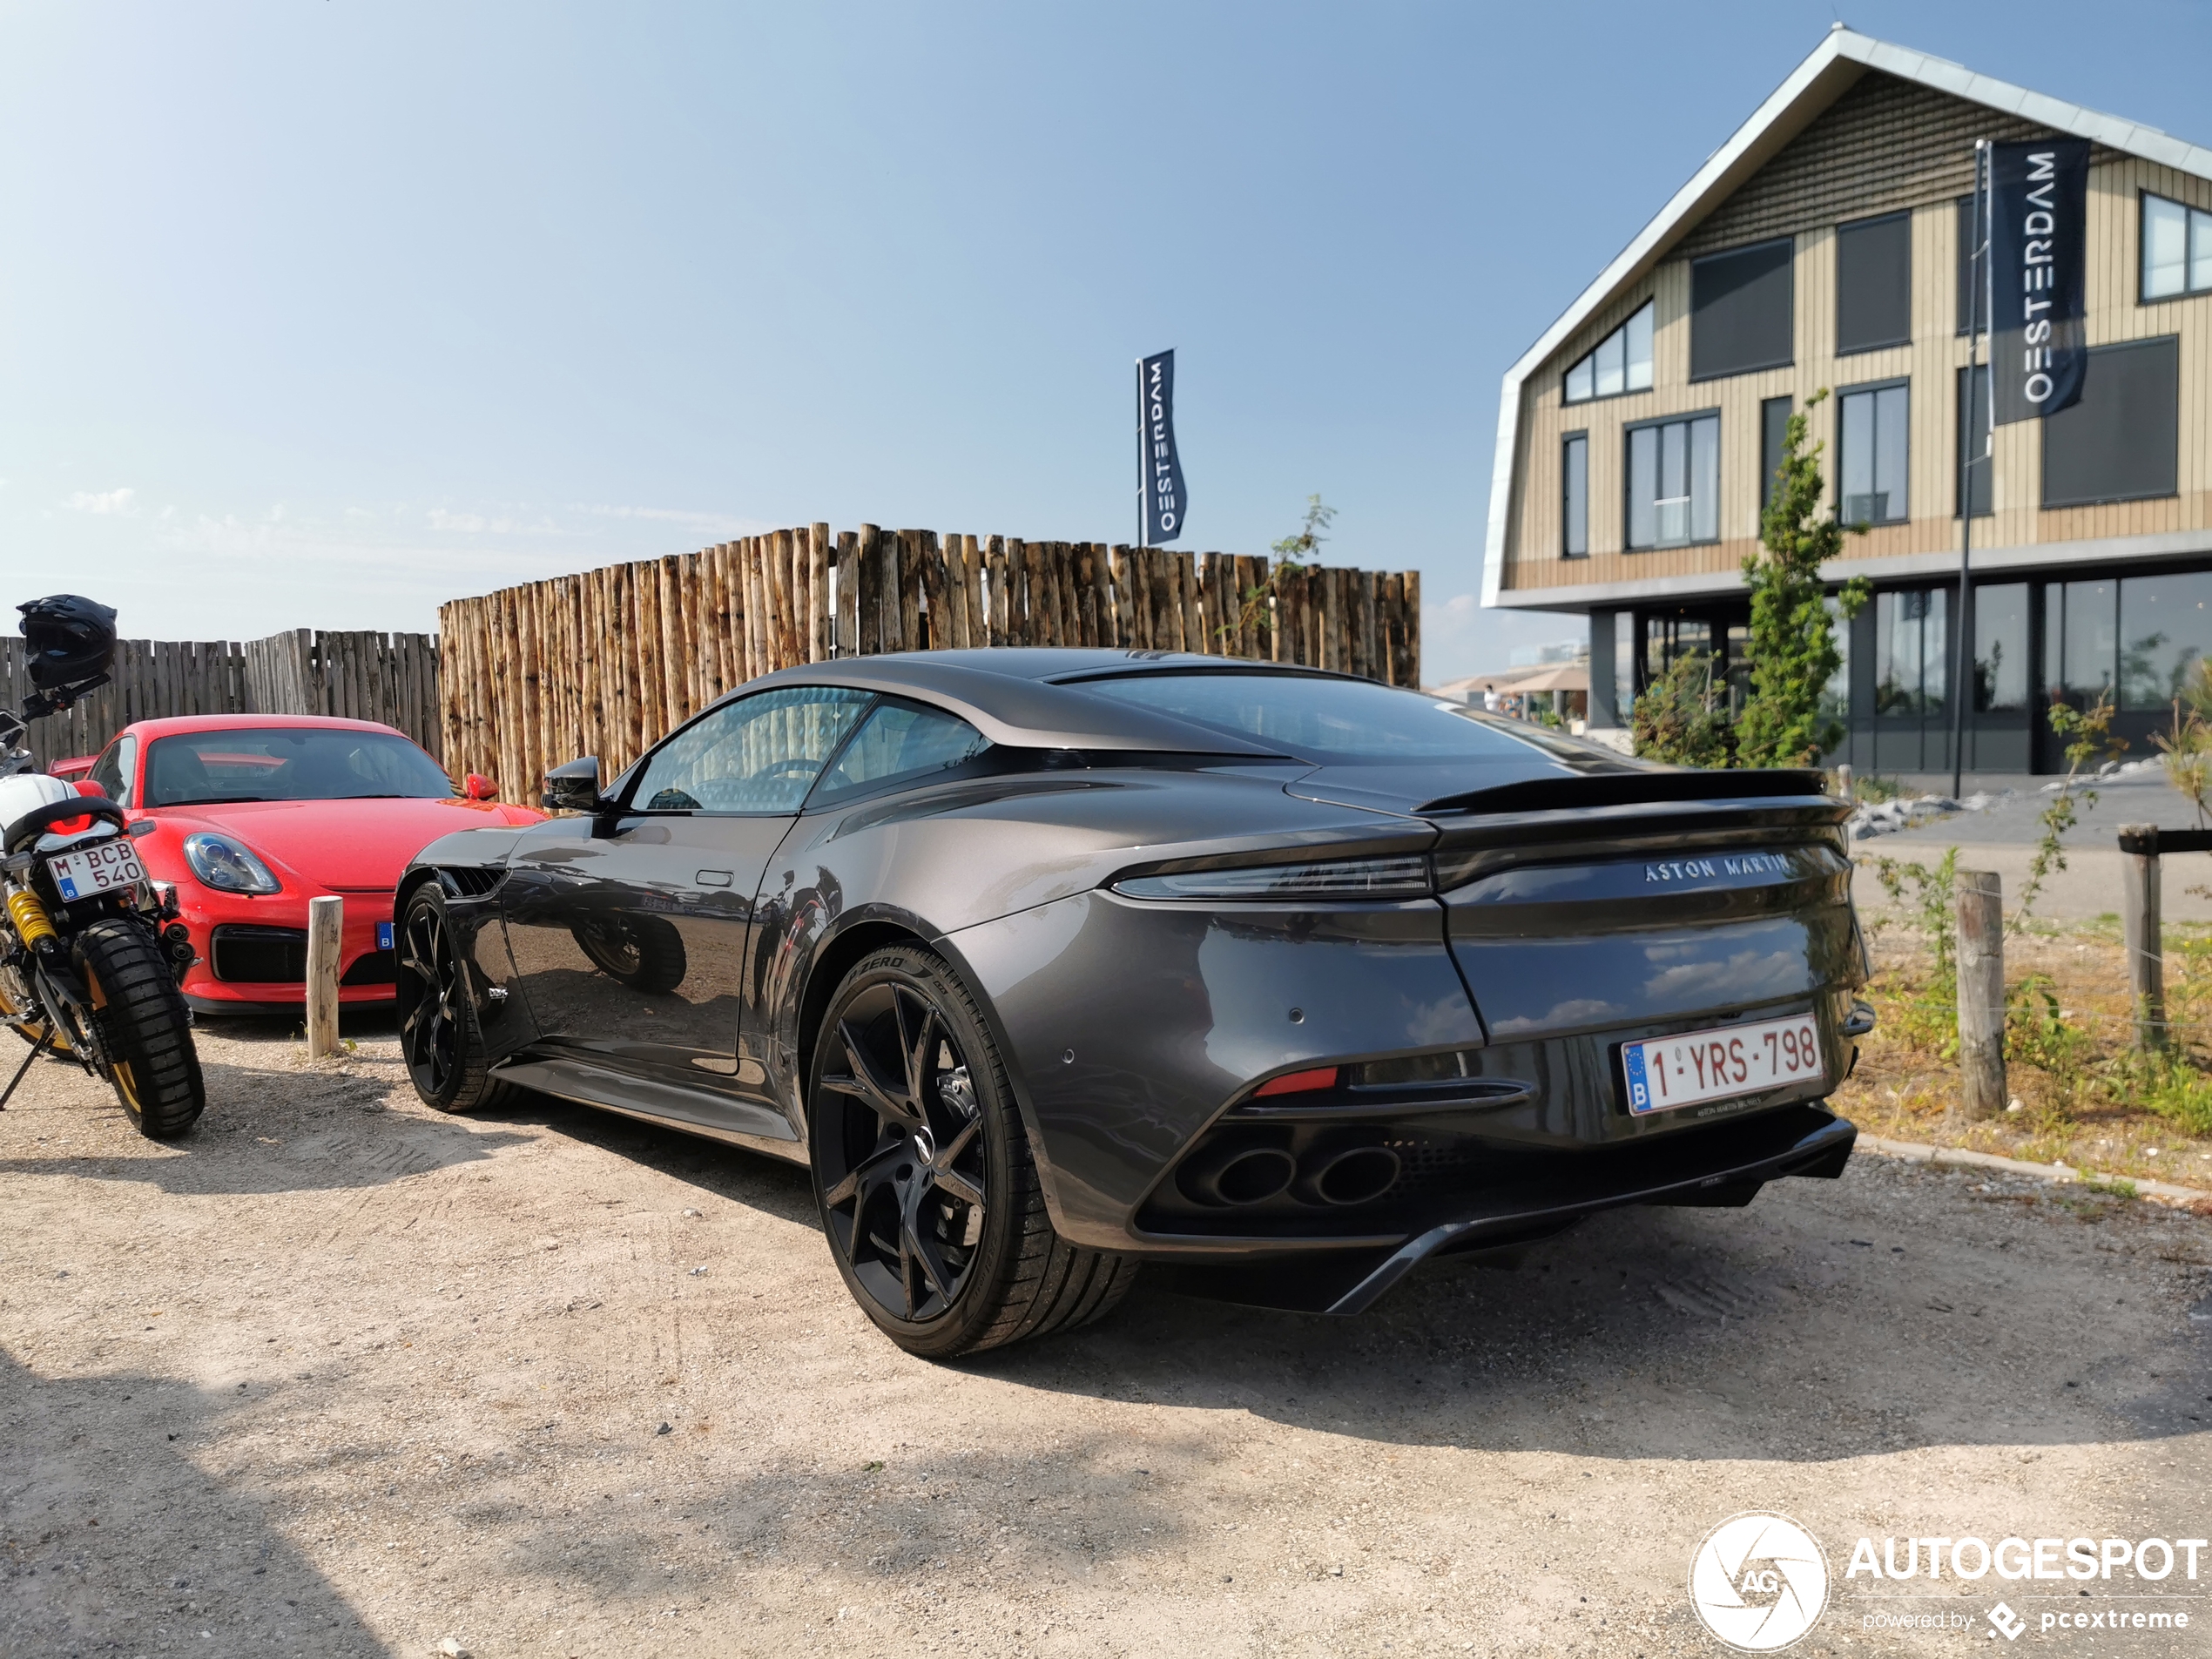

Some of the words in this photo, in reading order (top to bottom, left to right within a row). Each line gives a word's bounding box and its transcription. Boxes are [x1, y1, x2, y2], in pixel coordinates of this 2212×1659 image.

[2024, 151, 2056, 404] OESTERDAM
[1150, 361, 1176, 532] OESTERDAM
[93, 862, 140, 887] 540
[1645, 860, 1716, 882] ASTON
[1724, 853, 1790, 875] MARTIN
[67, 889, 75, 898] B
[381, 937, 389, 948] B
[860, 956, 904, 975] ZERO
[1633, 1082, 1646, 1105] B
